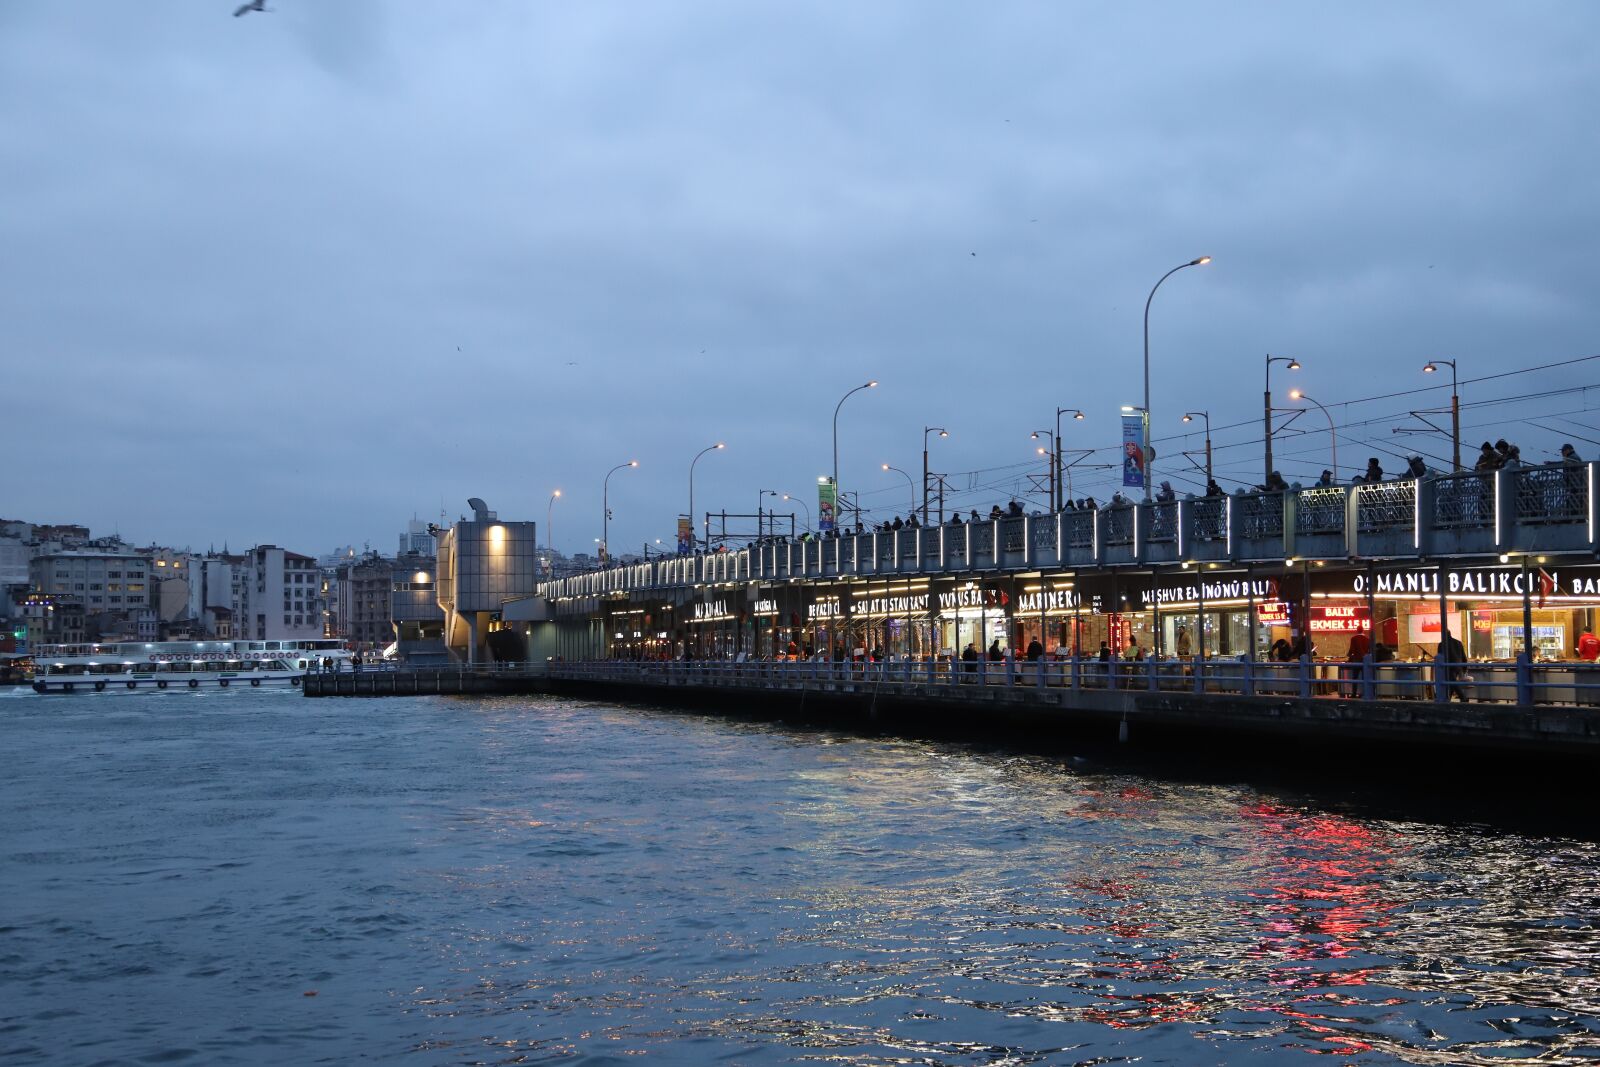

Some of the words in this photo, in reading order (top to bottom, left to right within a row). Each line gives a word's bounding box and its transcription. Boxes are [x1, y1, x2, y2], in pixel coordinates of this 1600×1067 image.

[1353, 572, 1438, 593] OMANLI
[1325, 607, 1354, 617] BALIK
[1310, 620, 1345, 629] EKMEK
[1347, 620, 1360, 629] 15
